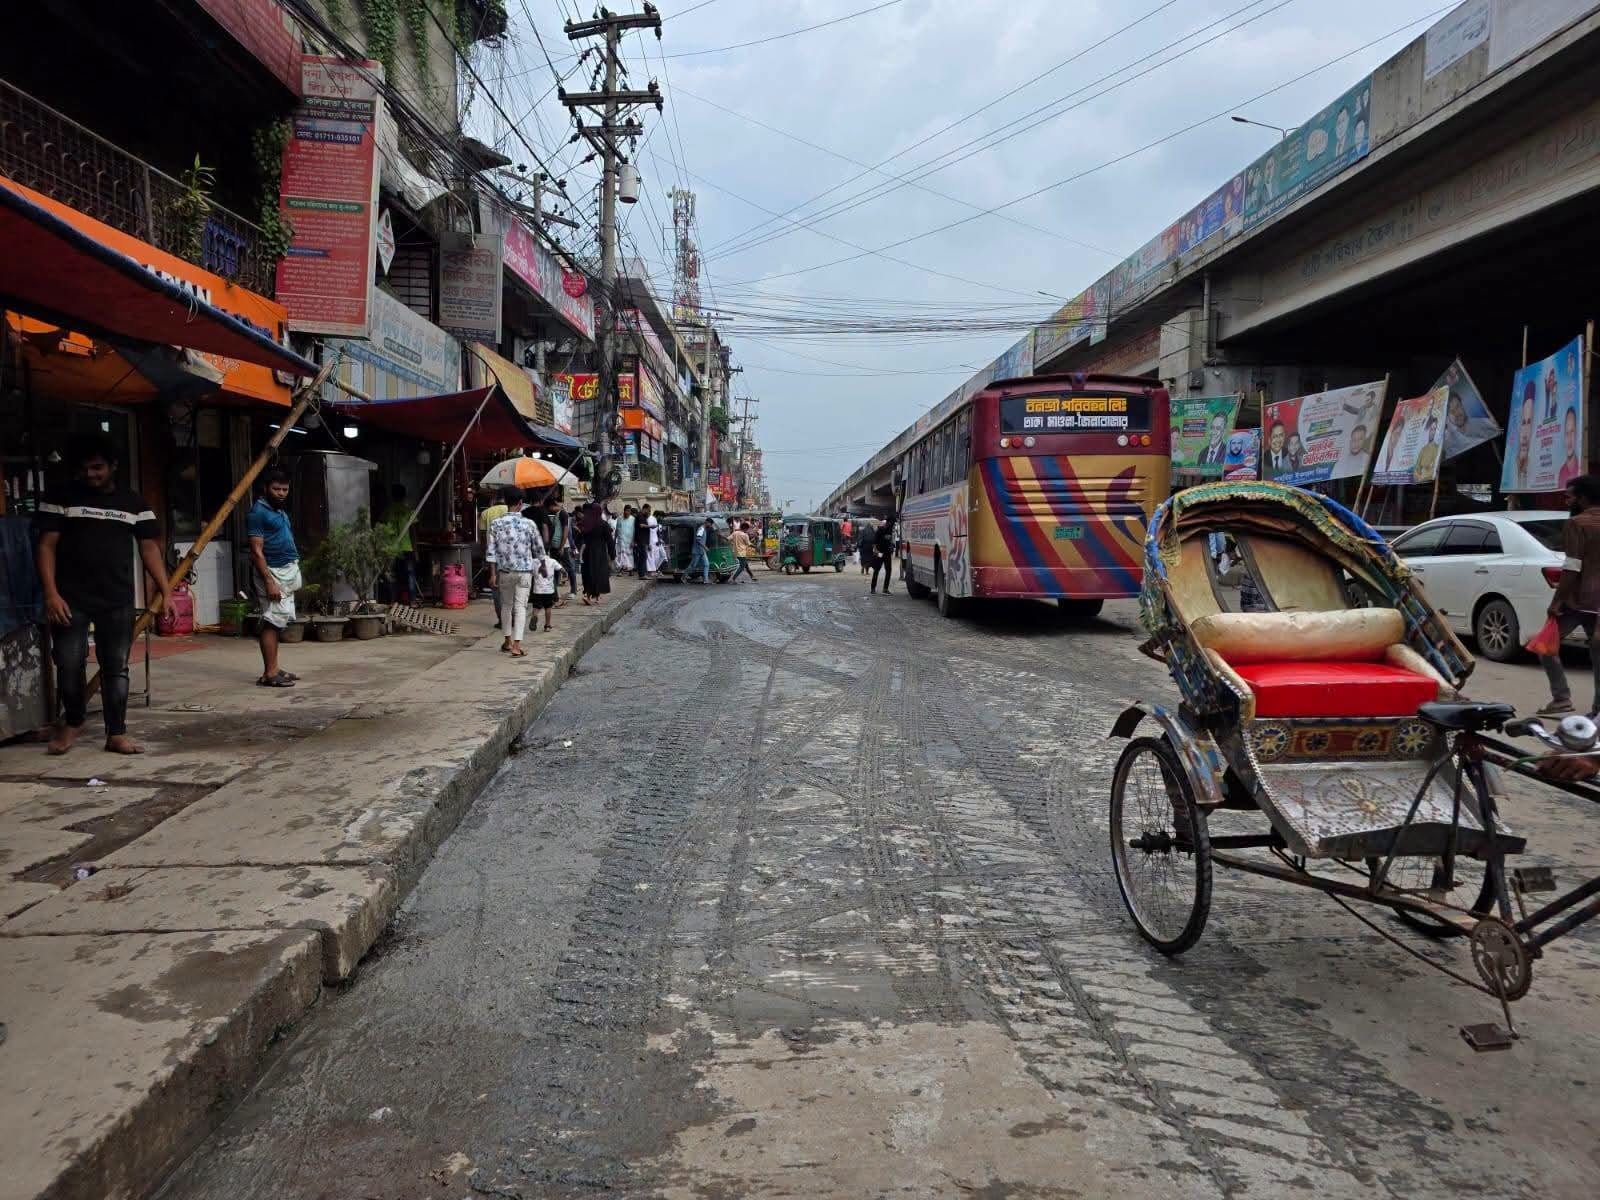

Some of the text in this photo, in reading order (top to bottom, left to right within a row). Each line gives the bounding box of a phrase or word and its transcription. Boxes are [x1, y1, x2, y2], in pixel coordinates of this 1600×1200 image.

[1026, 398, 1060, 413] বনশ্রী
[1061, 397, 1107, 413] পরিবহন
[1023, 416, 1044, 428] ঢাকা
